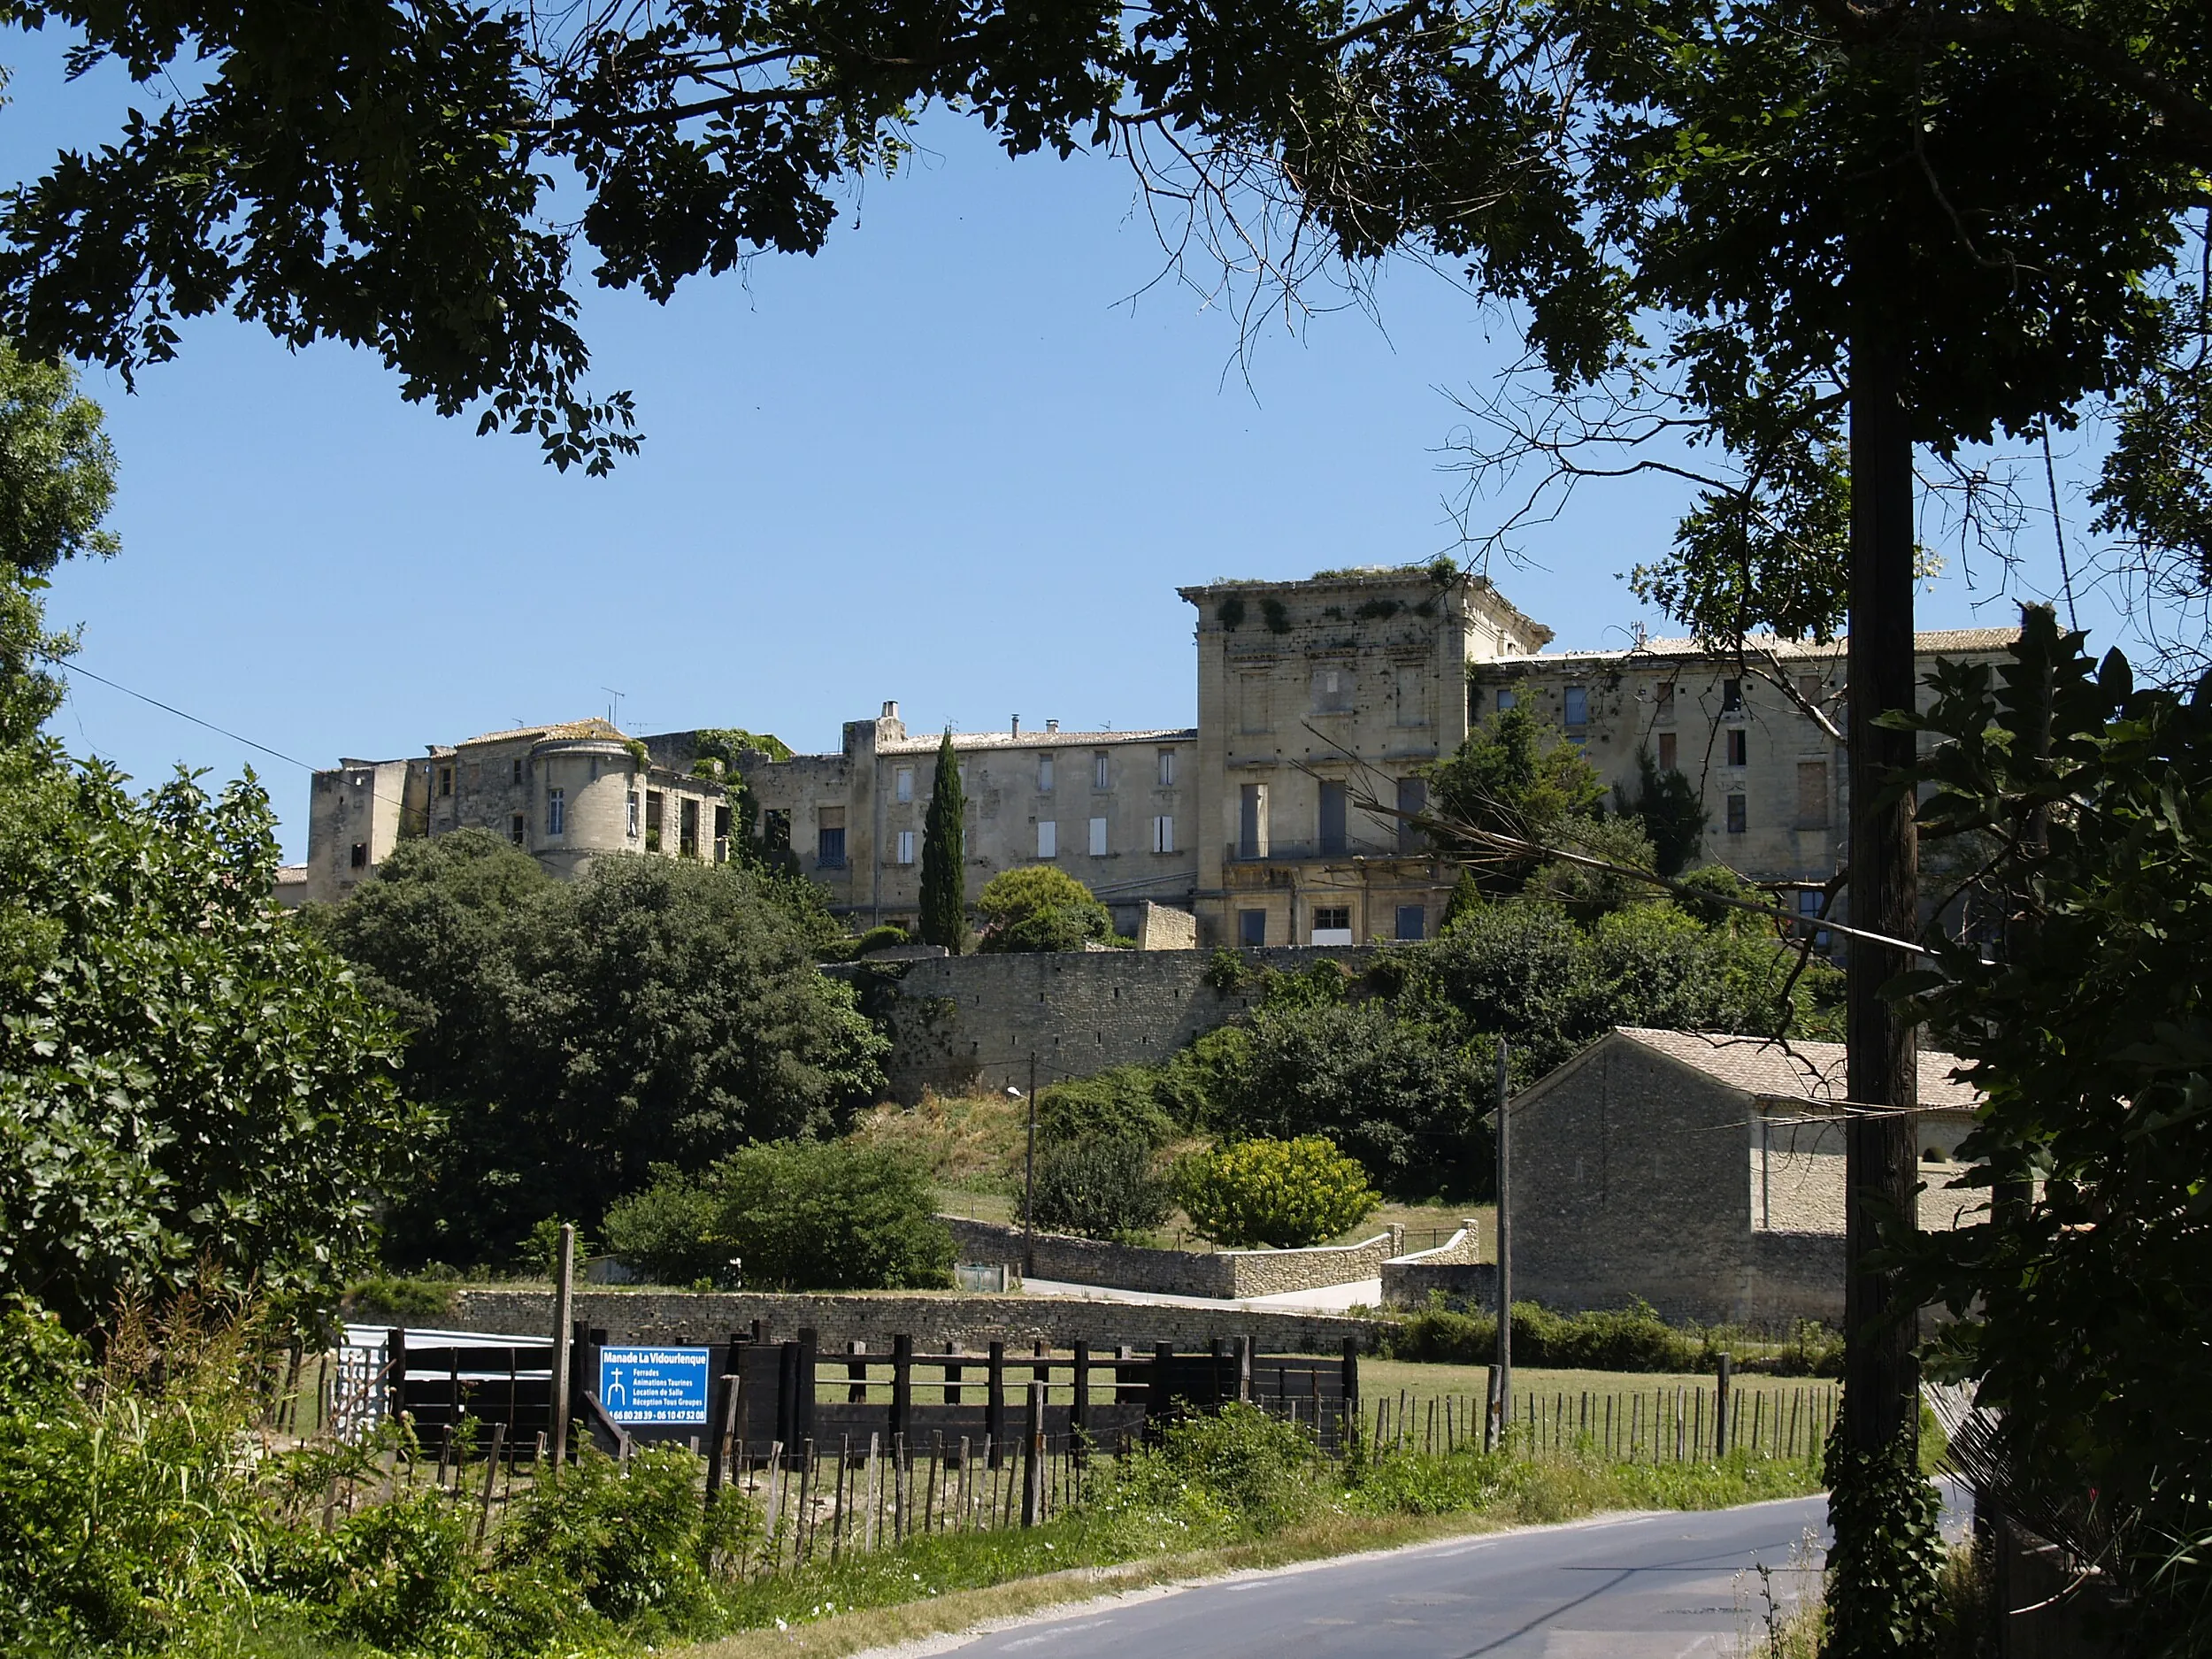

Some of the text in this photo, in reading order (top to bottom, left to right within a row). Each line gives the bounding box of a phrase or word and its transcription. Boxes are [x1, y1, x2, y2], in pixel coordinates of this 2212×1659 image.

[603, 1352, 706, 1366] Manade La Vidourlenque
[633, 1398, 663, 1407] Réception
[614, 1410, 623, 1419] 66
[624, 1410, 633, 1419] 80
[643, 1410, 652, 1419] 39
[657, 1410, 666, 1419] 06
[667, 1410, 676, 1419] 10
[677, 1410, 686, 1419] 47
[686, 1410, 695, 1419] 52
